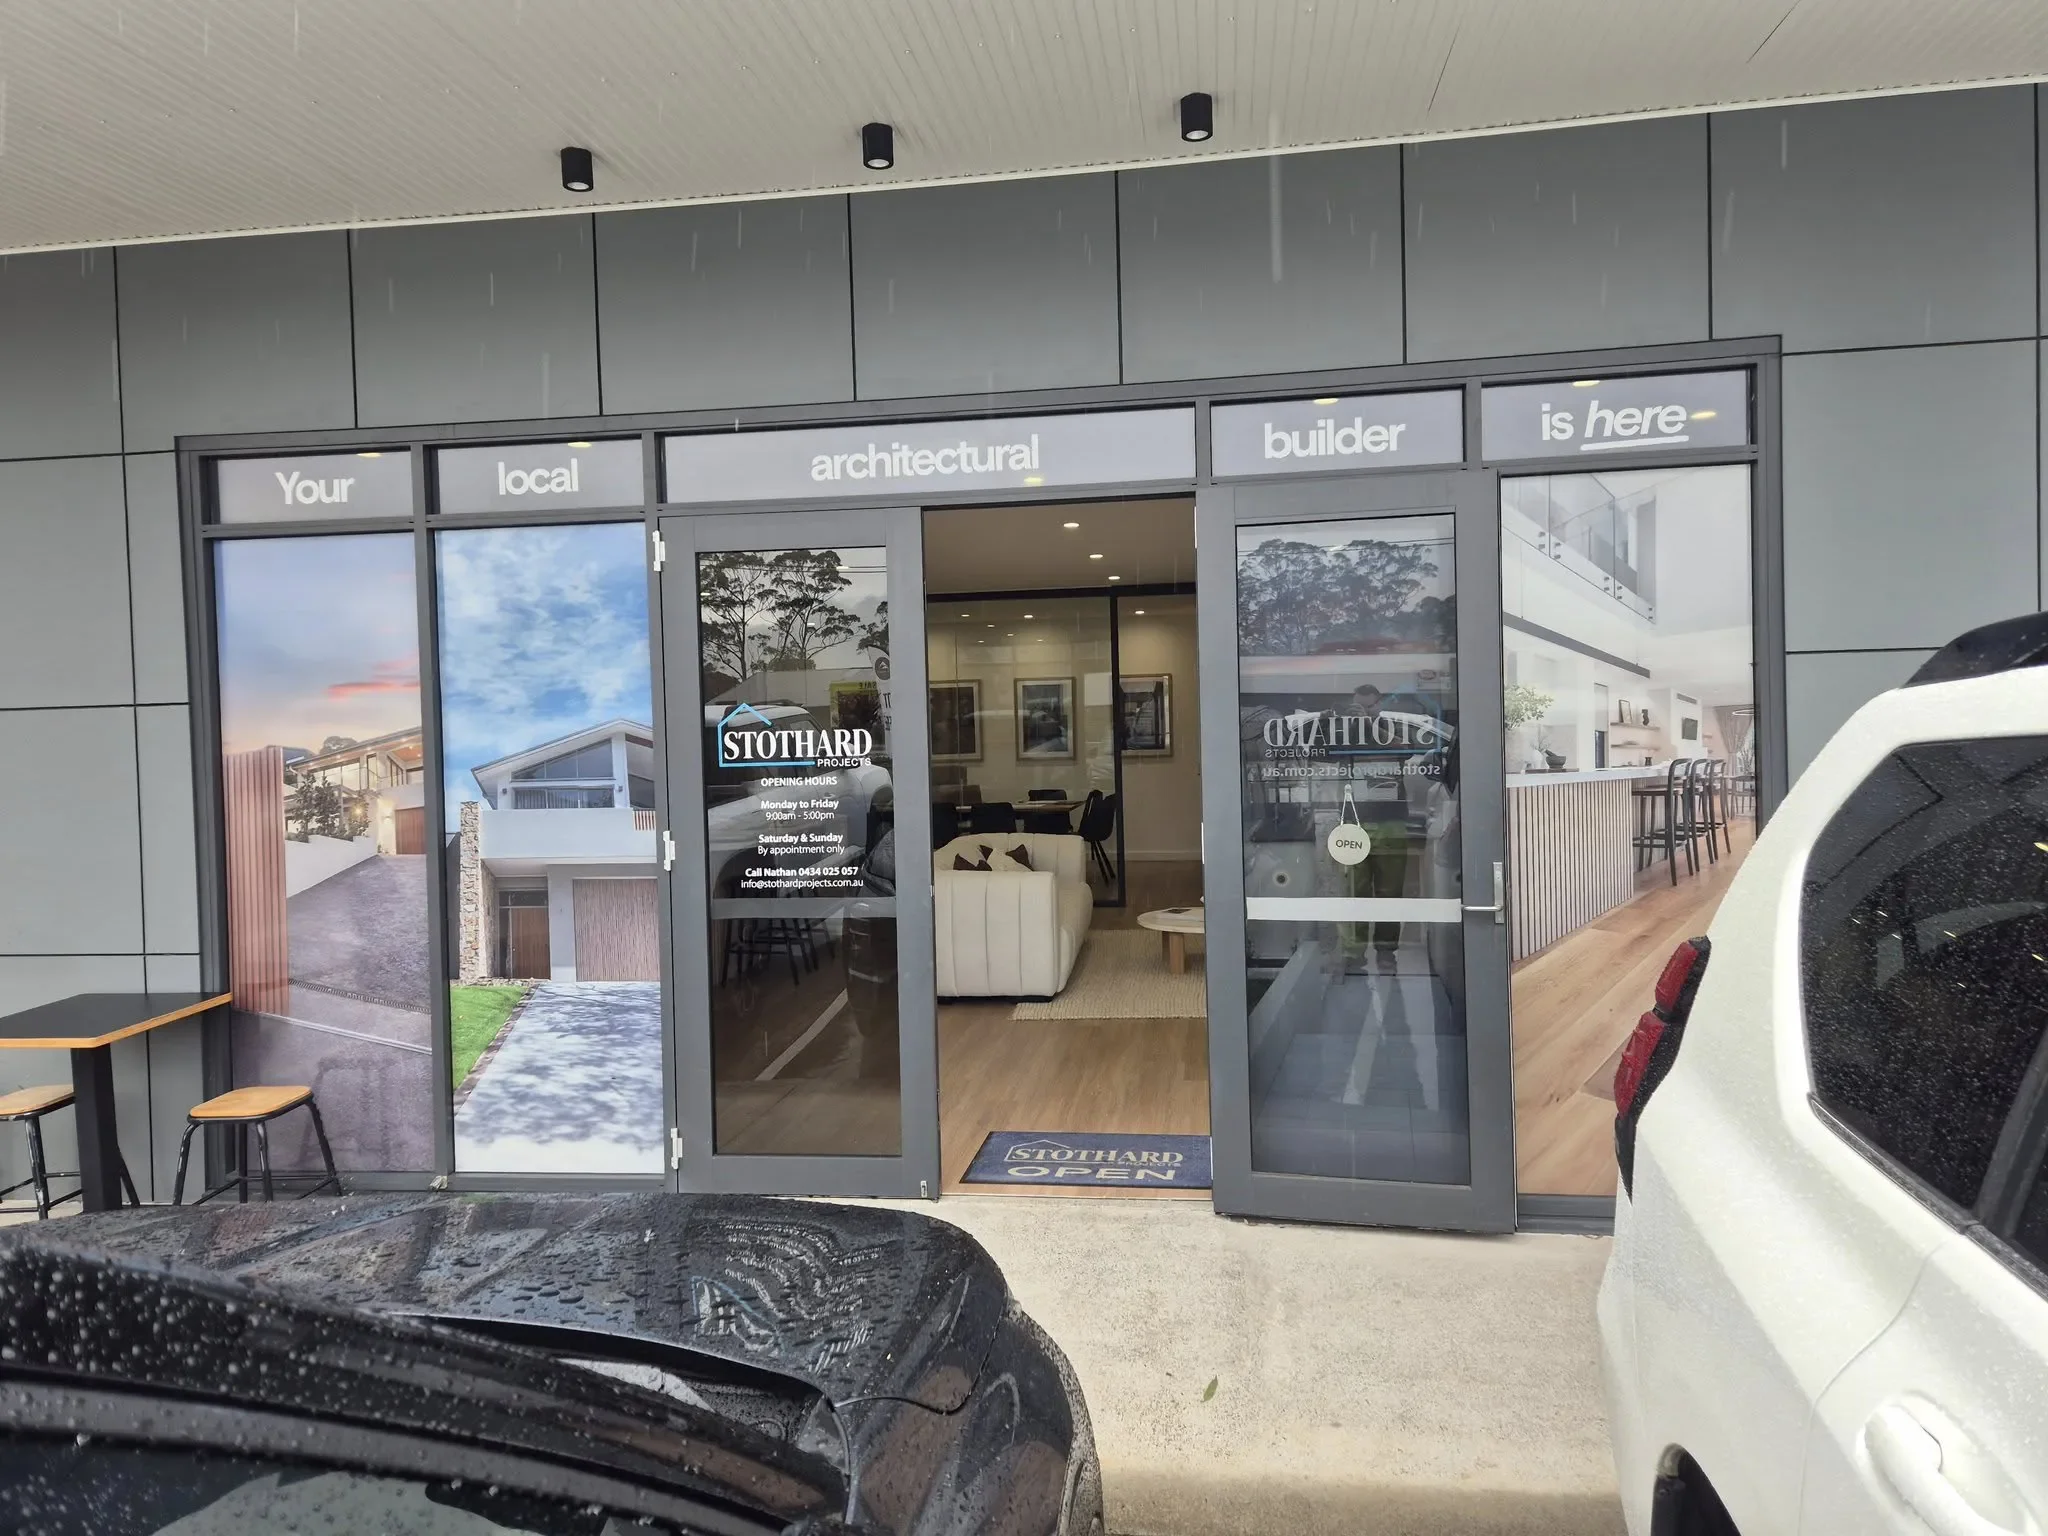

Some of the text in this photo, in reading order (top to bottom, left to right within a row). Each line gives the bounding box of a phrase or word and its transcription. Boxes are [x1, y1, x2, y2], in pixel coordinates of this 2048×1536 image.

[275, 400, 1688, 505] Your local architectural builder is here
[723, 728, 872, 760] STOTHARD
[817, 757, 872, 768] PROJECTS
[760, 776, 838, 787] OPENING HOURS
[760, 799, 839, 811] Monday to Friday
[765, 812, 796, 821] 9:00am
[803, 811, 835, 821] 5:00pm
[758, 833, 843, 844] Saturday & Sunday
[1335, 839, 1363, 849] OPEN
[758, 844, 845, 856] By appointment only
[745, 866, 859, 877] Call Nathan 0434 025 057
[741, 878, 864, 889] info@stothardprojects.com.au
[1011, 1148, 1184, 1163] STOTHARD
[1007, 1166, 1176, 1181] OPEN
